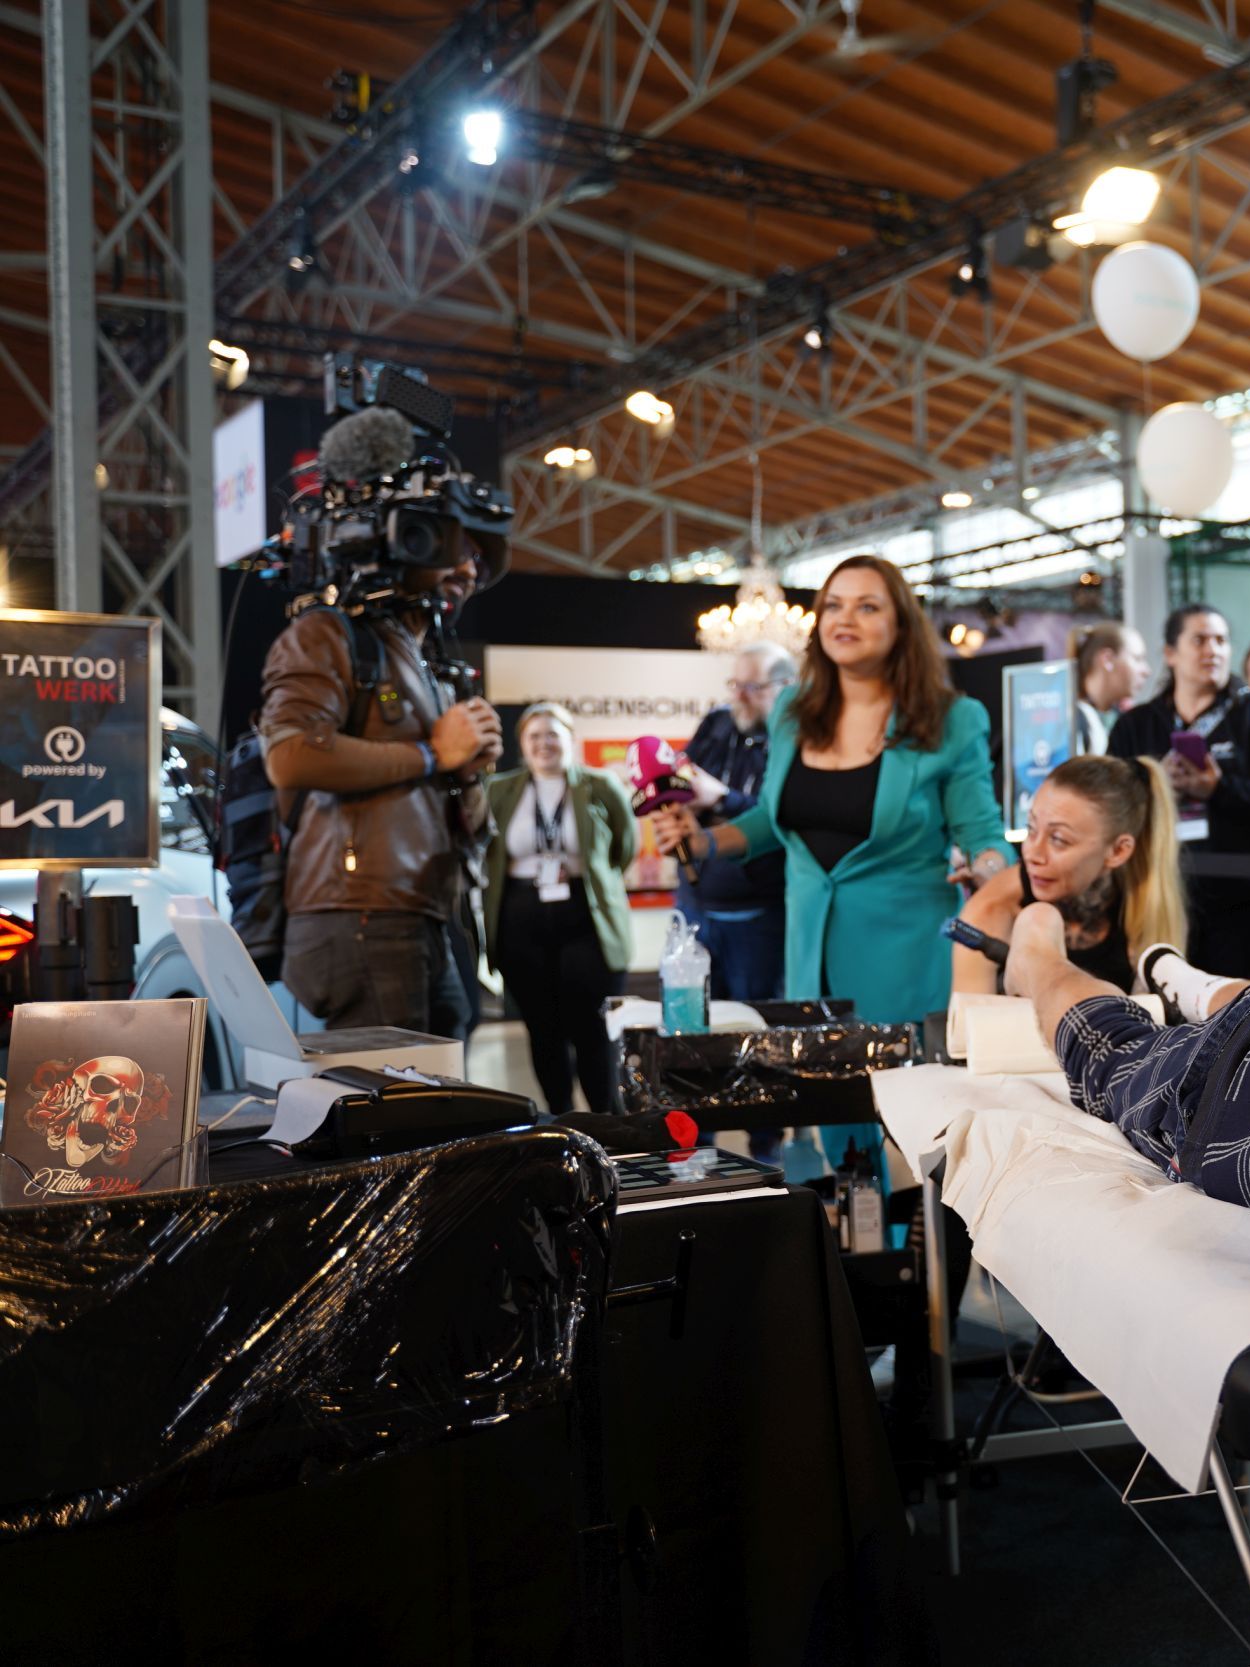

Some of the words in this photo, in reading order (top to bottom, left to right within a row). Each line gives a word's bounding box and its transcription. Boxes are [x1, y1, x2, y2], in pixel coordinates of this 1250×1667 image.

[2, 654, 117, 679] TATTOO
[36, 680, 118, 704] WERK
[22, 763, 86, 778] powered
[87, 763, 107, 779] by
[24, 1168, 92, 1199] Tattoo
